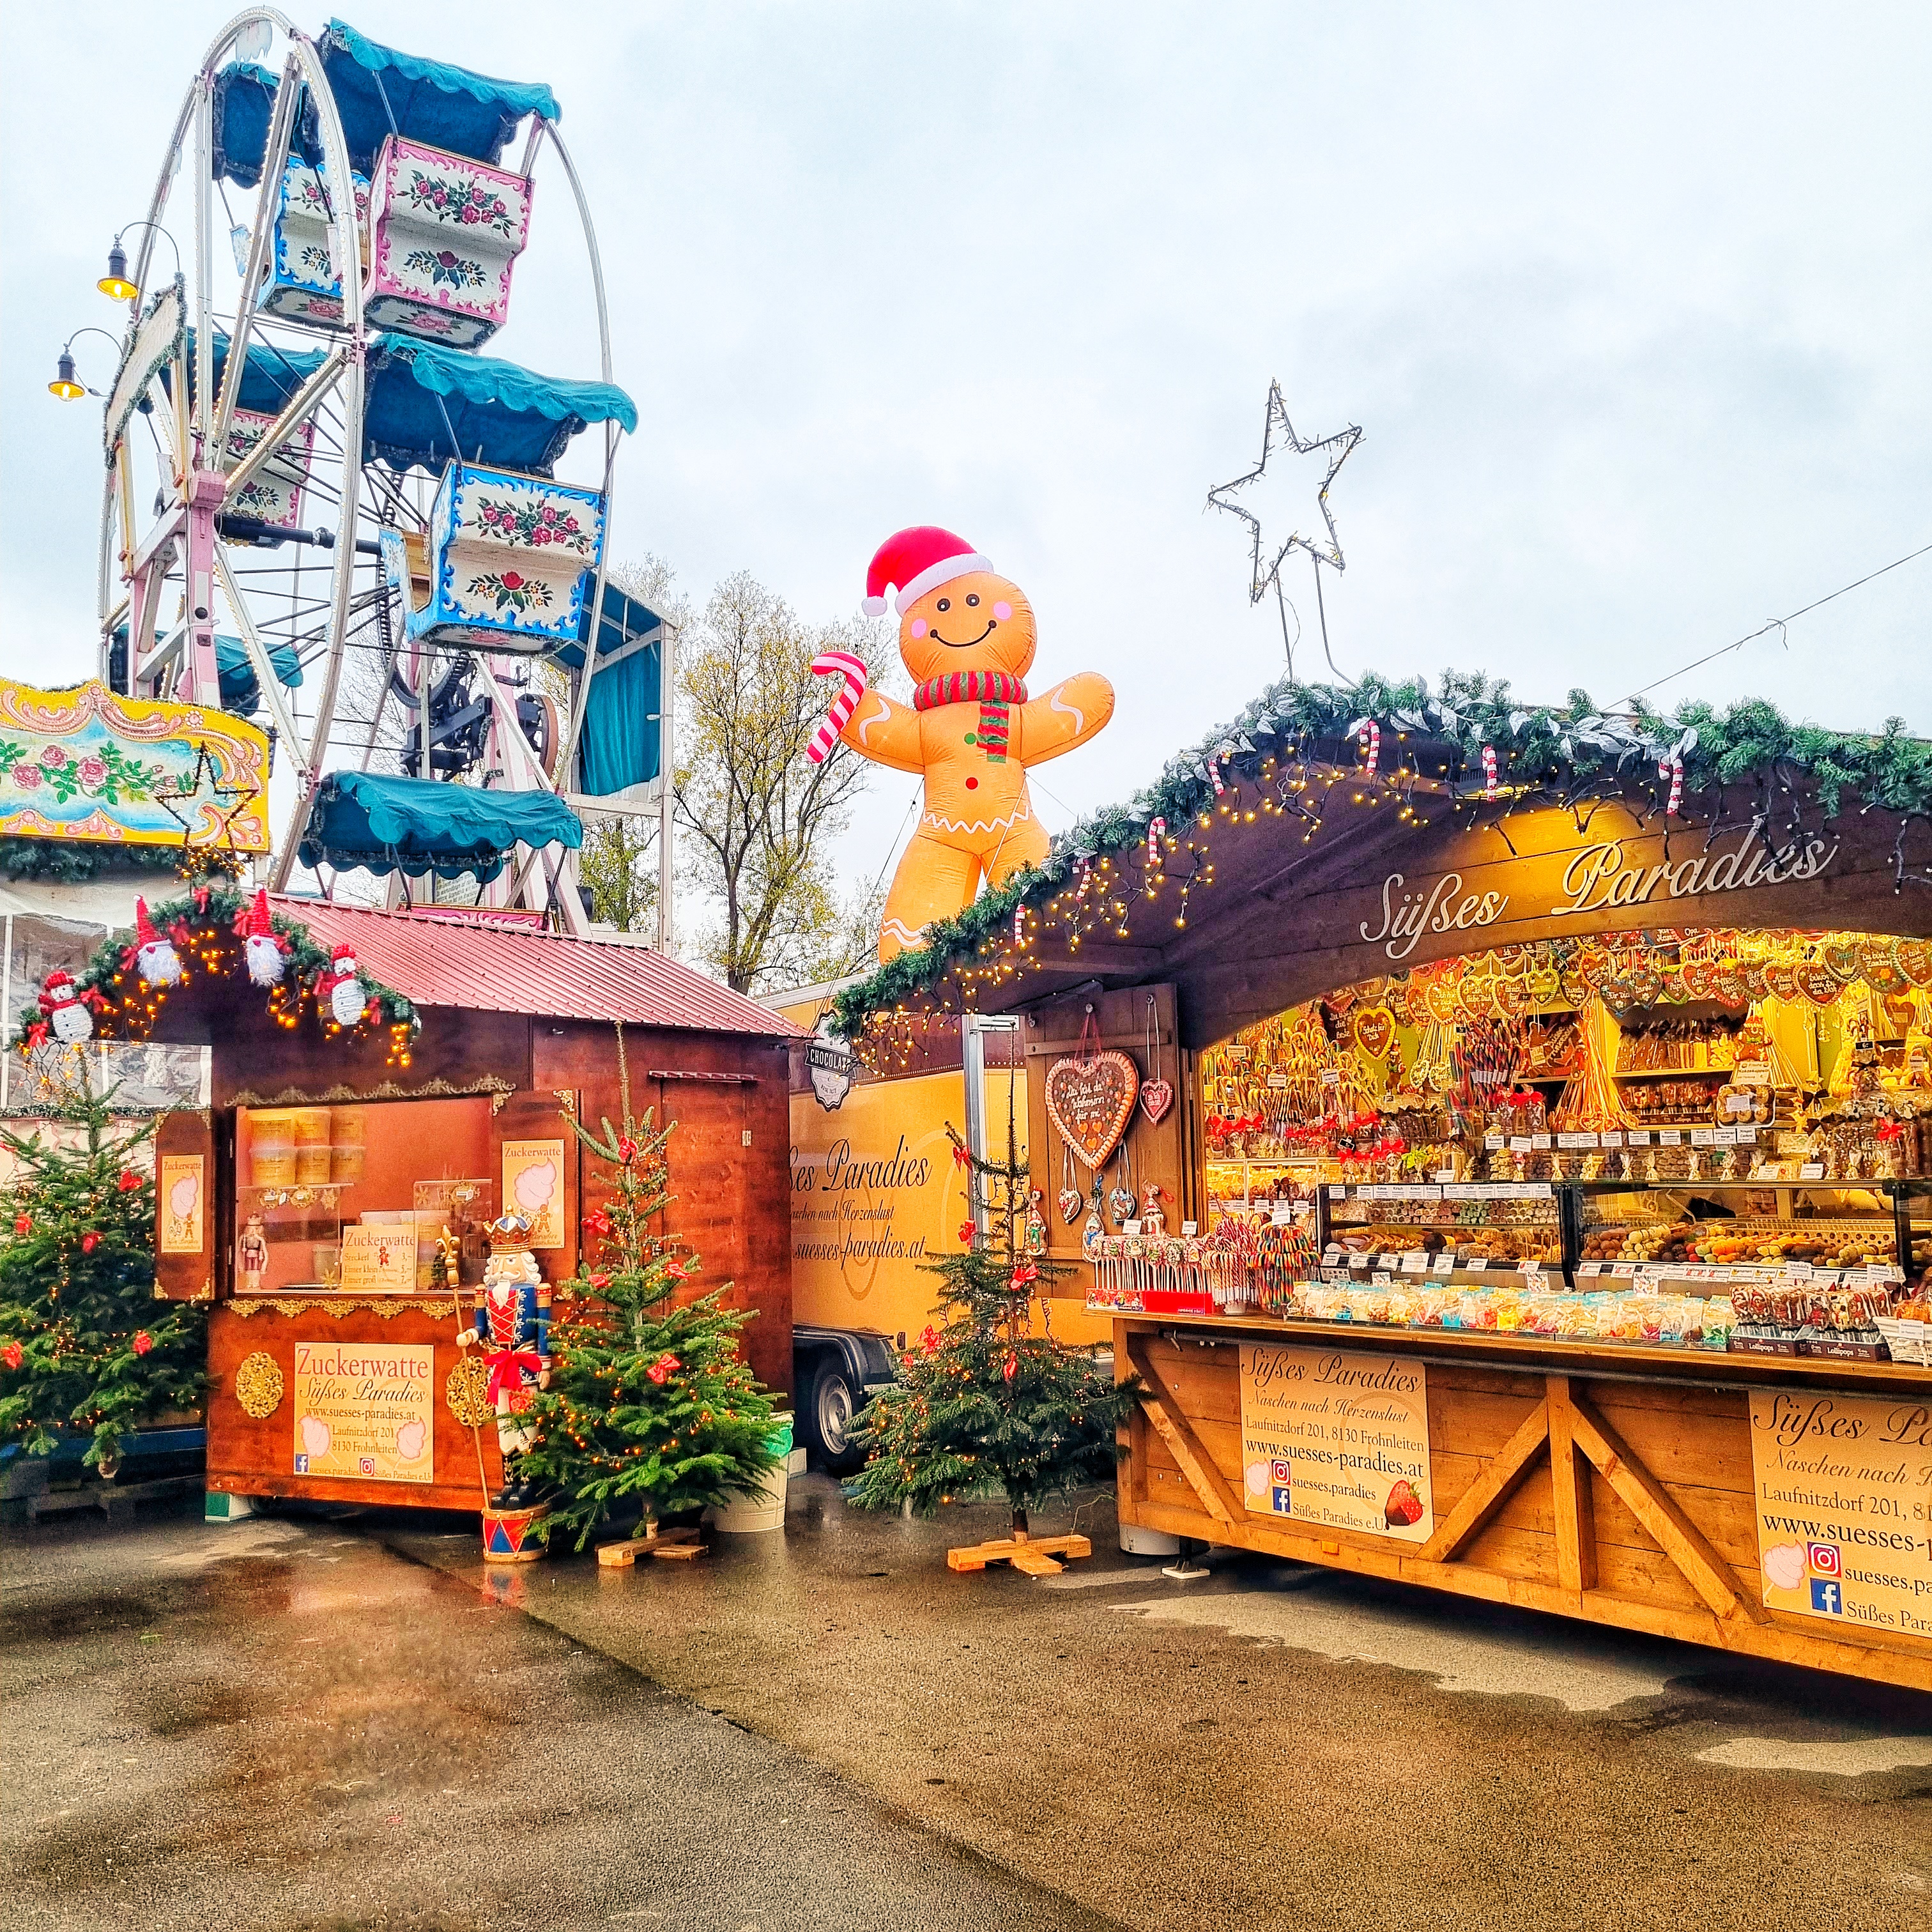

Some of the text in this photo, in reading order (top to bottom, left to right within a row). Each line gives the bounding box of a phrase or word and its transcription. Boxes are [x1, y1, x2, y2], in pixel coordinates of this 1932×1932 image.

[1360, 829, 1839, 960] Süßes Paradies
[1071, 1094, 1105, 1109] Wahnsinn
[1075, 1108, 1088, 1124] für
[505, 1147, 561, 1157] Zuckerwatte
[822, 1134, 933, 1191] Paradies
[164, 1161, 202, 1170] Zuckerwatte
[818, 1200, 838, 1221] nach
[841, 1199, 895, 1221] Herzenslust
[346, 1231, 415, 1246] Zuckerwatte
[1748, 1342, 1774, 1353] Lollipops
[1827, 1347, 1854, 1357] Lollipops
[298, 1347, 429, 1379] Zuckerwatte
[1241, 1347, 1422, 1393] Süßes Paradies
[299, 1377, 428, 1406] Süßes Paradies
[305, 1406, 415, 1421] www.suesses-paradies.at
[1248, 1388, 1410, 1423] Naschen nach Herzenslust
[332, 1424, 379, 1437] Laufnitzdorf
[1752, 1393, 1870, 1446] Süßes
[1245, 1414, 1425, 1452] Laufnitzdorf 201, 8130 Frohnleiten
[332, 1441, 397, 1454] 8130 Frohnleiten
[1245, 1439, 1425, 1478] www.suesses-paradies.at
[393, 1470, 417, 1480] Paradies
[1766, 1447, 1855, 1478] Naschen
[1857, 1461, 1911, 1485] nach
[1292, 1476, 1376, 1501] suesses.paradies
[1762, 1482, 1864, 1513] Laufnitzdorf
[1869, 1496, 1907, 1521] 201,
[1292, 1502, 1321, 1520] Süßes
[1323, 1507, 1363, 1527] Paradies
[1846, 1600, 1895, 1625] Süßes
